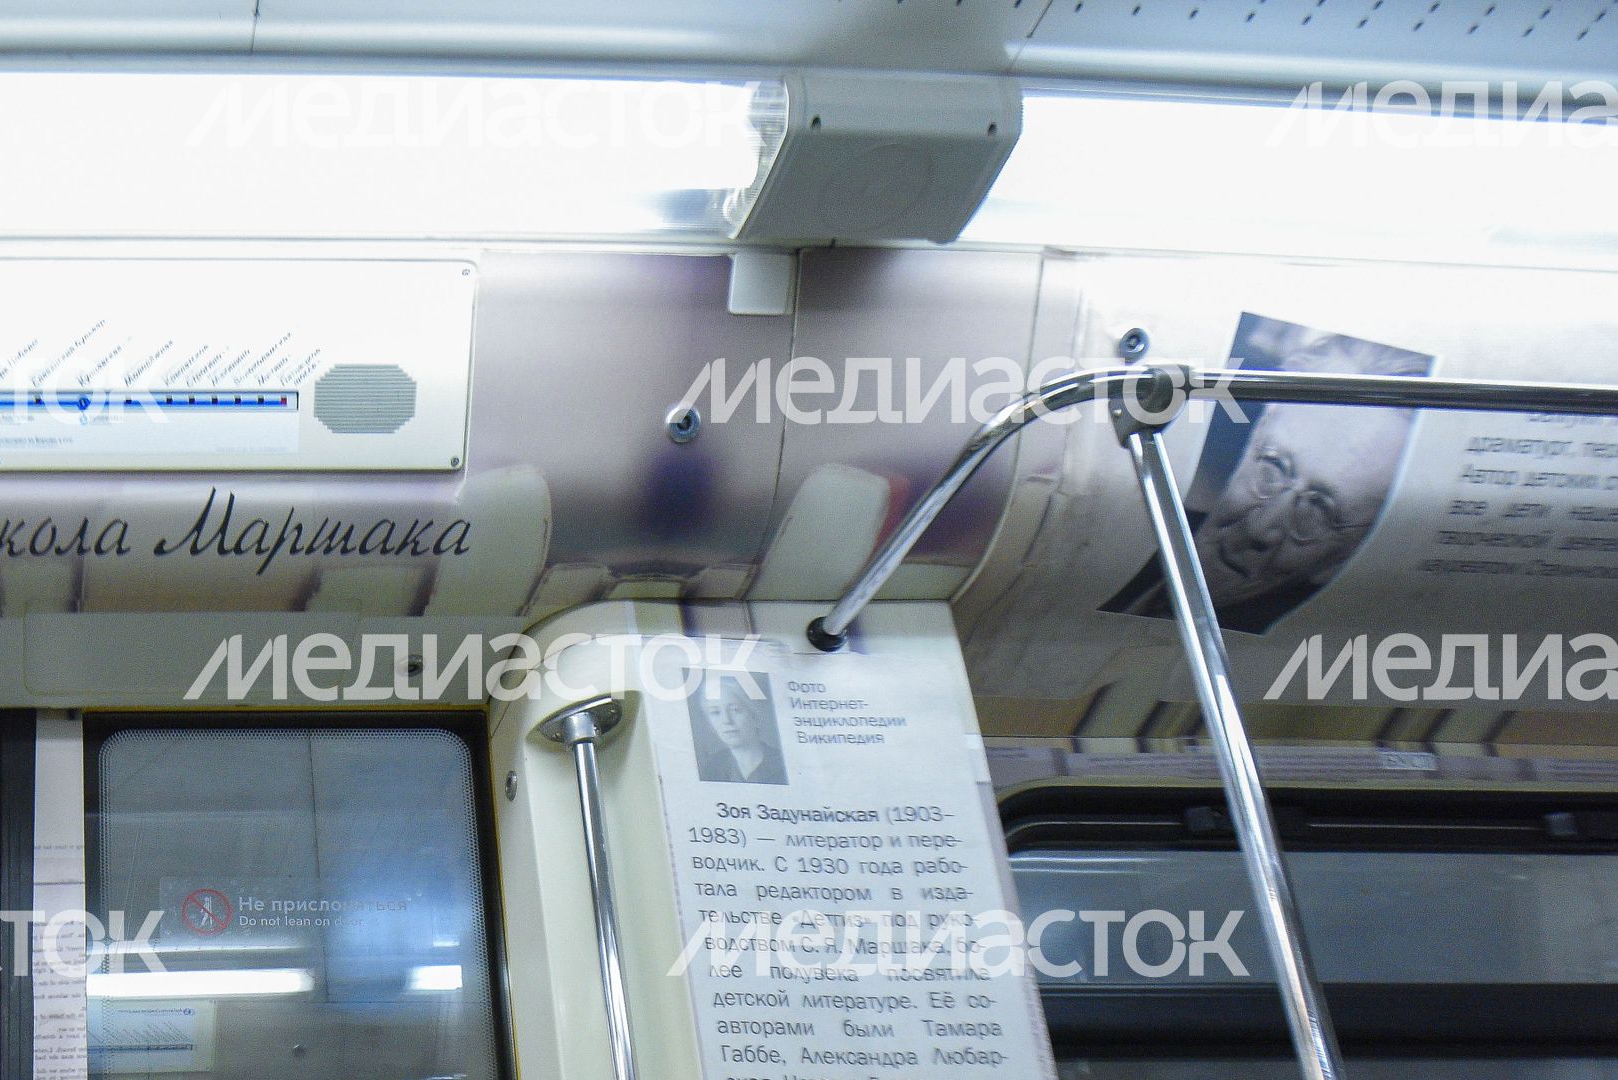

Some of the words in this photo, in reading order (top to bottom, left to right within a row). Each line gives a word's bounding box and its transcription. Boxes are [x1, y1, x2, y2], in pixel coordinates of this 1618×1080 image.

[153, 486, 471, 576] Маршака
[788, 681, 826, 694] Фото
[790, 698, 869, 710] Интернет-
[793, 716, 907, 727] энциклопедии
[798, 731, 884, 745] Википедия
[716, 802, 751, 820] Зоя
[757, 803, 880, 824] Задунайская
[689, 827, 747, 847] 1983)
[786, 834, 883, 850] литератор
[890, 835, 901, 848] и
[909, 834, 963, 851] пере-
[693, 857, 765, 872] водчик.
[775, 857, 788, 873] С
[798, 858, 848, 874] 1930
[860, 860, 903, 874] года
[915, 857, 968, 876] рабо-
[695, 882, 737, 898] тала
[756, 884, 872, 902] редактором
[891, 887, 902, 900] в
[922, 887, 973, 902] изда-
[239, 897, 265, 911] Не
[239, 916, 257, 926] Do
[260, 916, 281, 926] not
[285, 916, 311, 926] lean
[315, 918, 331, 927] on
[699, 909, 782, 924] тельстве
[884, 913, 918, 928] под
[928, 915, 980, 929] руко-
[704, 938, 795, 952] водством
[709, 965, 742, 978] лее
[770, 965, 858, 982] полувека
[714, 989, 790, 1007] детской
[802, 992, 917, 1014] литературе.
[930, 989, 955, 1008] Её
[968, 992, 997, 1009] со-
[718, 1020, 814, 1037] авторами
[843, 1018, 894, 1038] были
[922, 1018, 1002, 1039] Тамара
[722, 1044, 786, 1064] Габбе,
[801, 1046, 918, 1066] Александра
[933, 1048, 1008, 1066] Любар-
